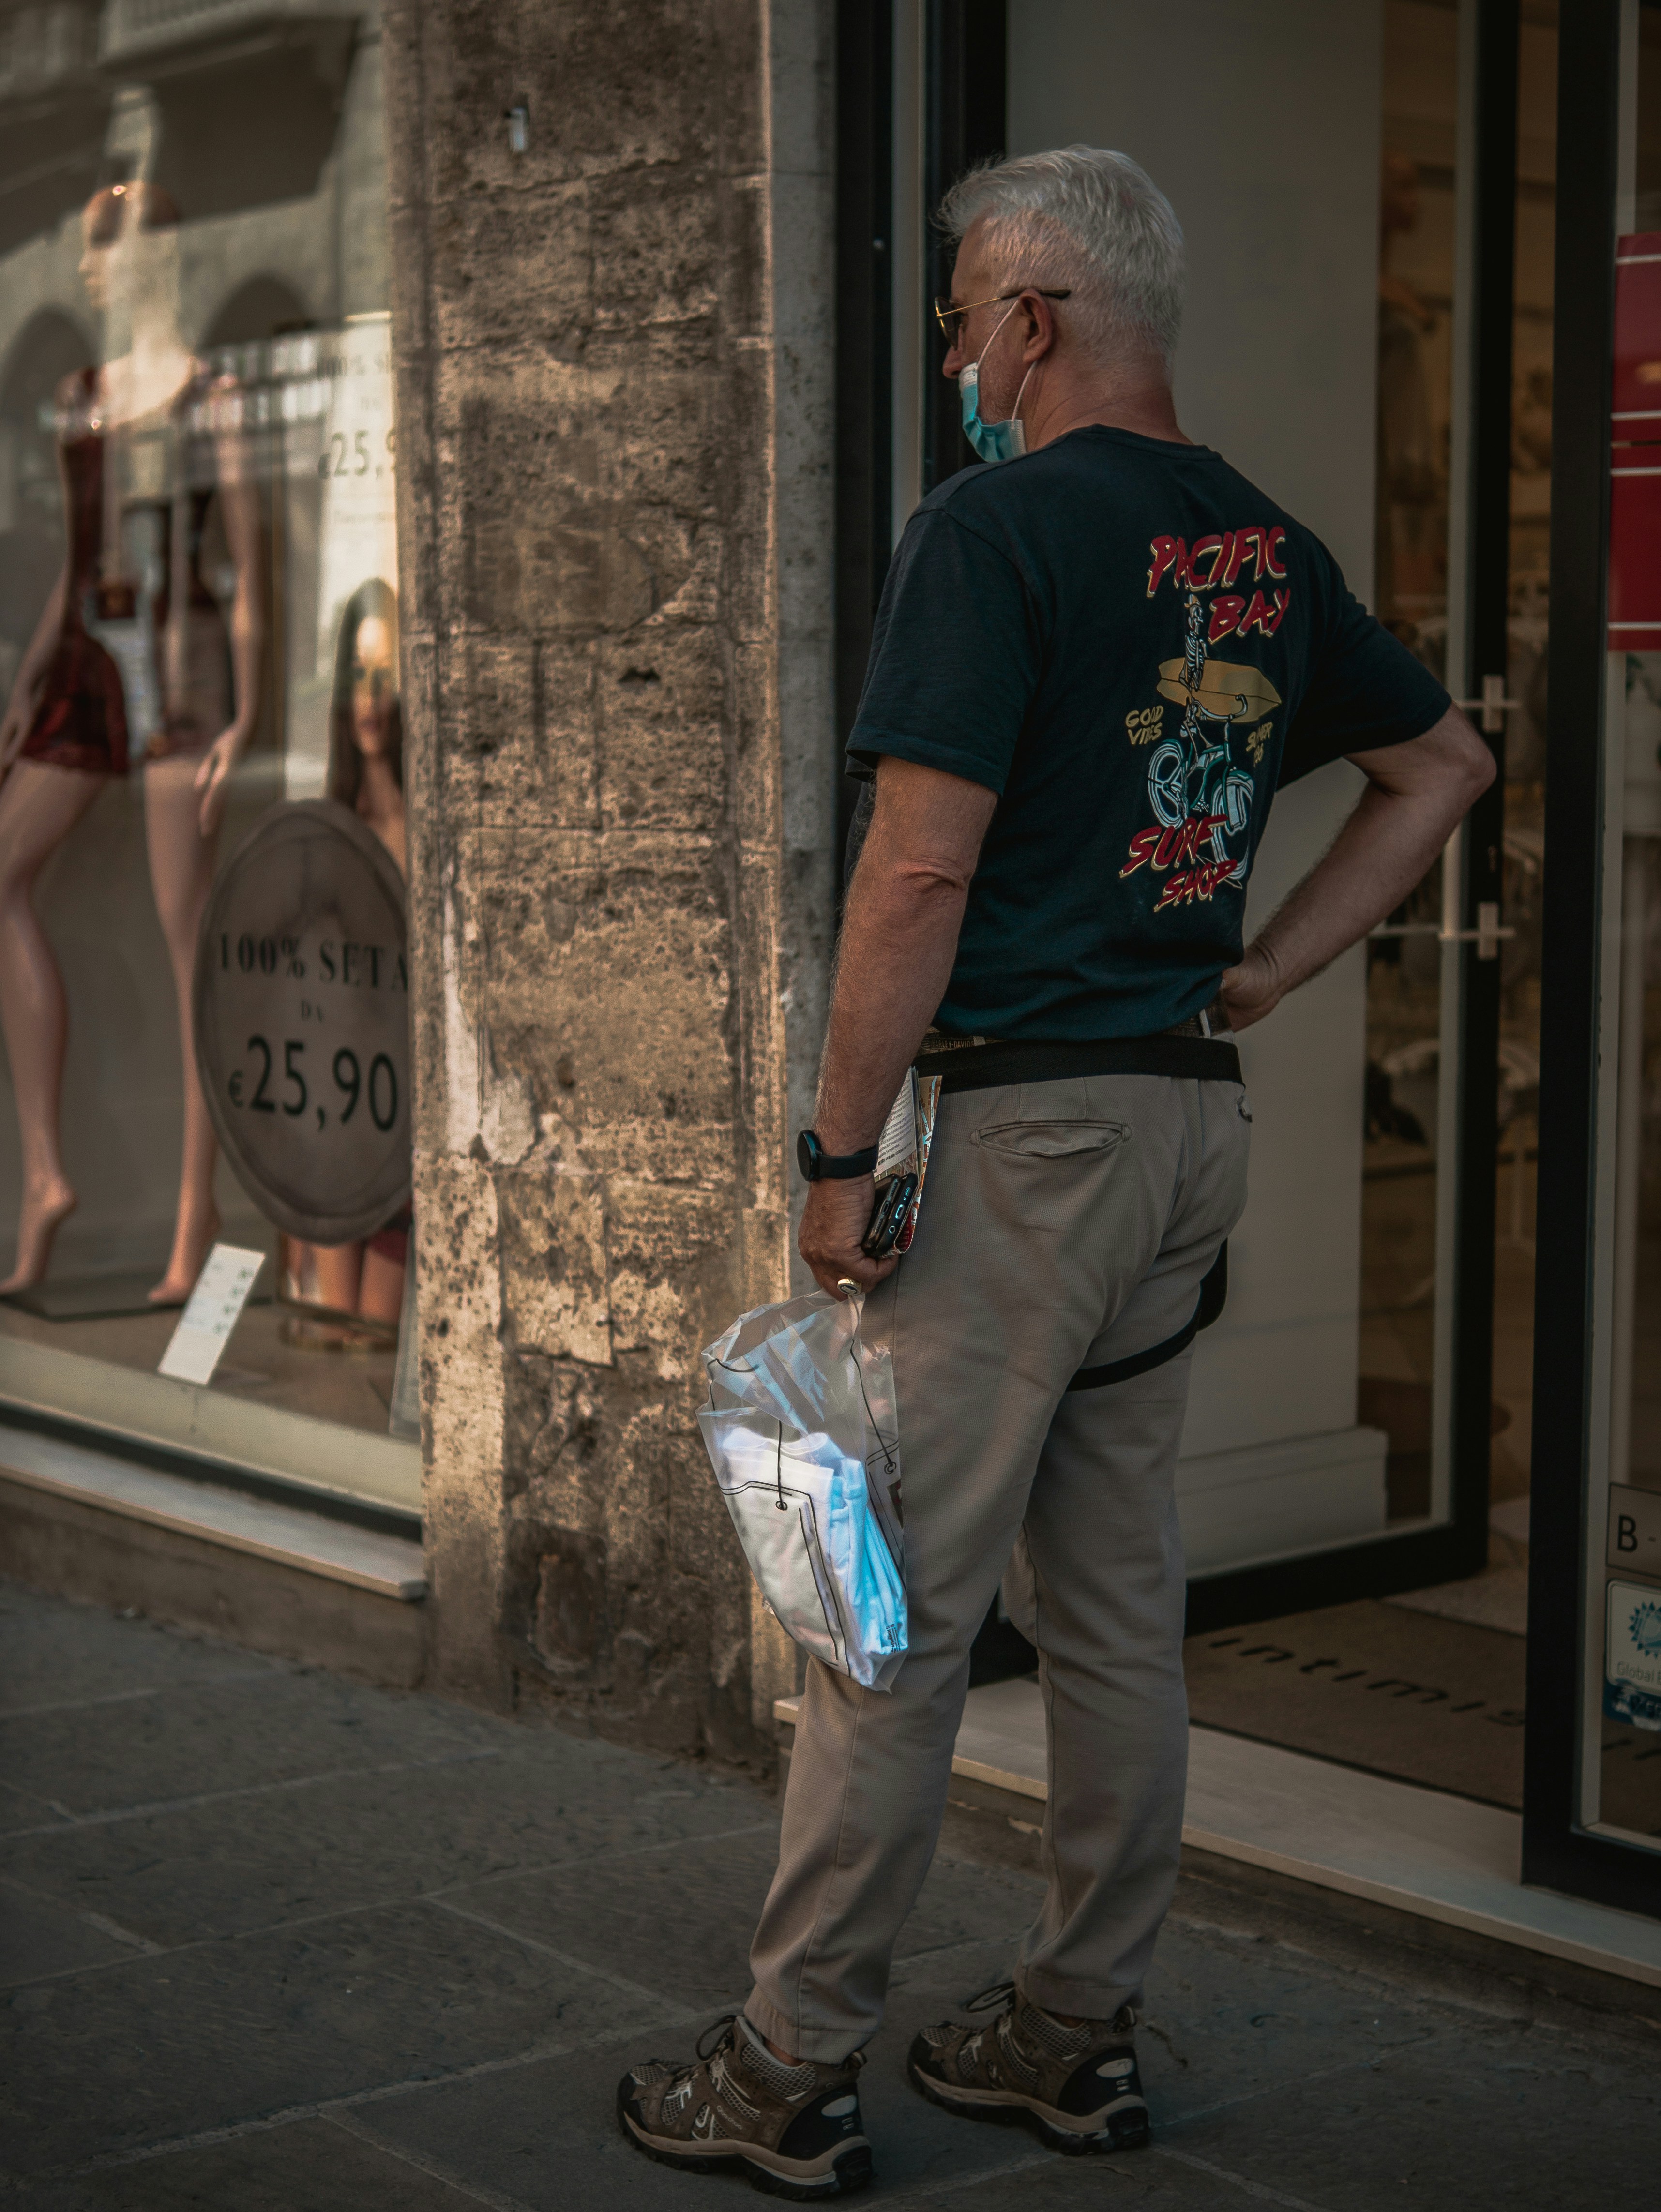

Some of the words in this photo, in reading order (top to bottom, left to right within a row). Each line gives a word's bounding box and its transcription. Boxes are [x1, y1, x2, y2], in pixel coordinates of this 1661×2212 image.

[1208, 588, 1291, 645] BAY
[1119, 814, 1229, 878] SURF
[1153, 859, 1238, 913] SHOP
[221, 933, 305, 979] 100%
[1617, 1515, 1638, 1552] B
